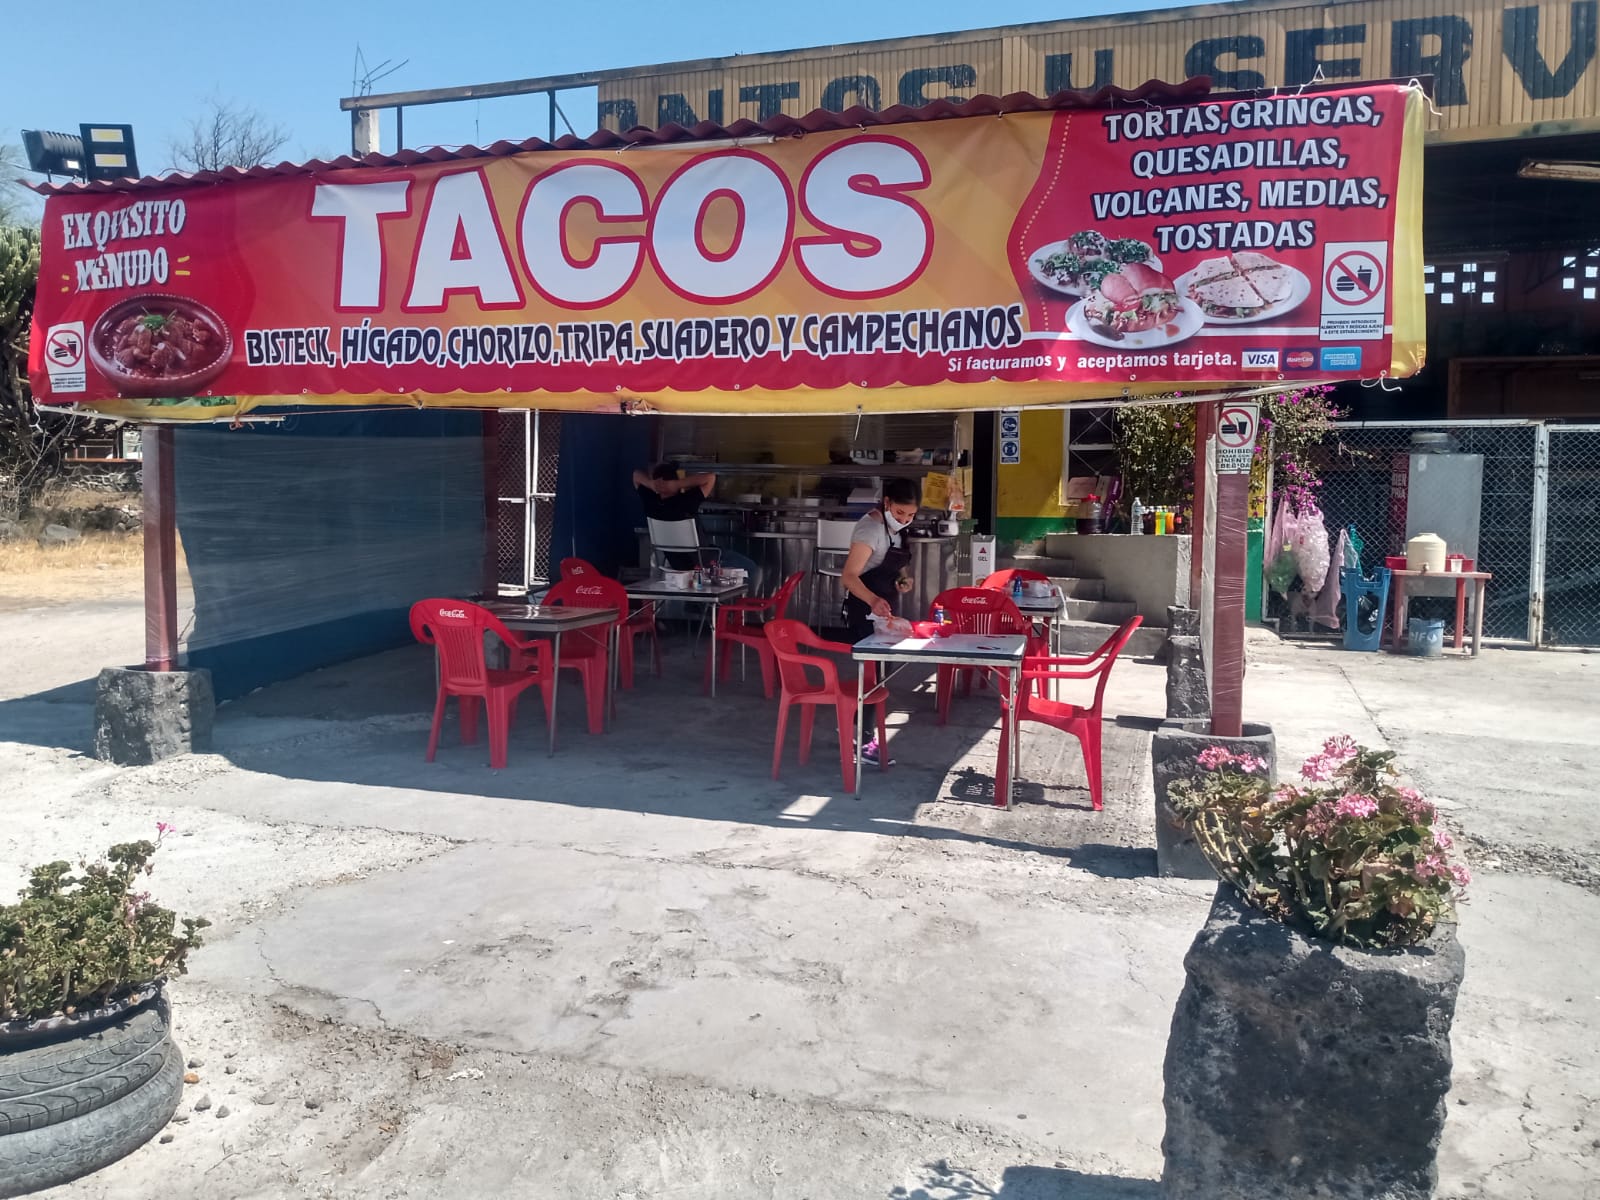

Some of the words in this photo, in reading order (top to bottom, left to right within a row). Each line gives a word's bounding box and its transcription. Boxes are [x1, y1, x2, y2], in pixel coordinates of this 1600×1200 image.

[1230, 95, 1381, 128] GRINGAS,
[1133, 137, 1347, 180] QUESADILLAS,
[1094, 182, 1249, 218] VOLCANES,
[1260, 177, 1387, 208] MEDIAS,
[61, 198, 186, 252] EXQUISITO
[309, 137, 931, 309] TACOS
[1157, 219, 1314, 252] TOSTADAS
[74, 246, 169, 293] MENUDO
[245, 328, 336, 367] BISTECK,
[776, 314, 798, 361] Y
[801, 304, 1023, 359] CAMPECHANOS
[948, 357, 962, 372] Si
[966, 354, 1052, 371] facturamos
[1057, 355, 1067, 372] y
[1077, 352, 1168, 372] aceptamos
[1173, 350, 1238, 370] tarjeta.
[1248, 354, 1275, 365] VISA
